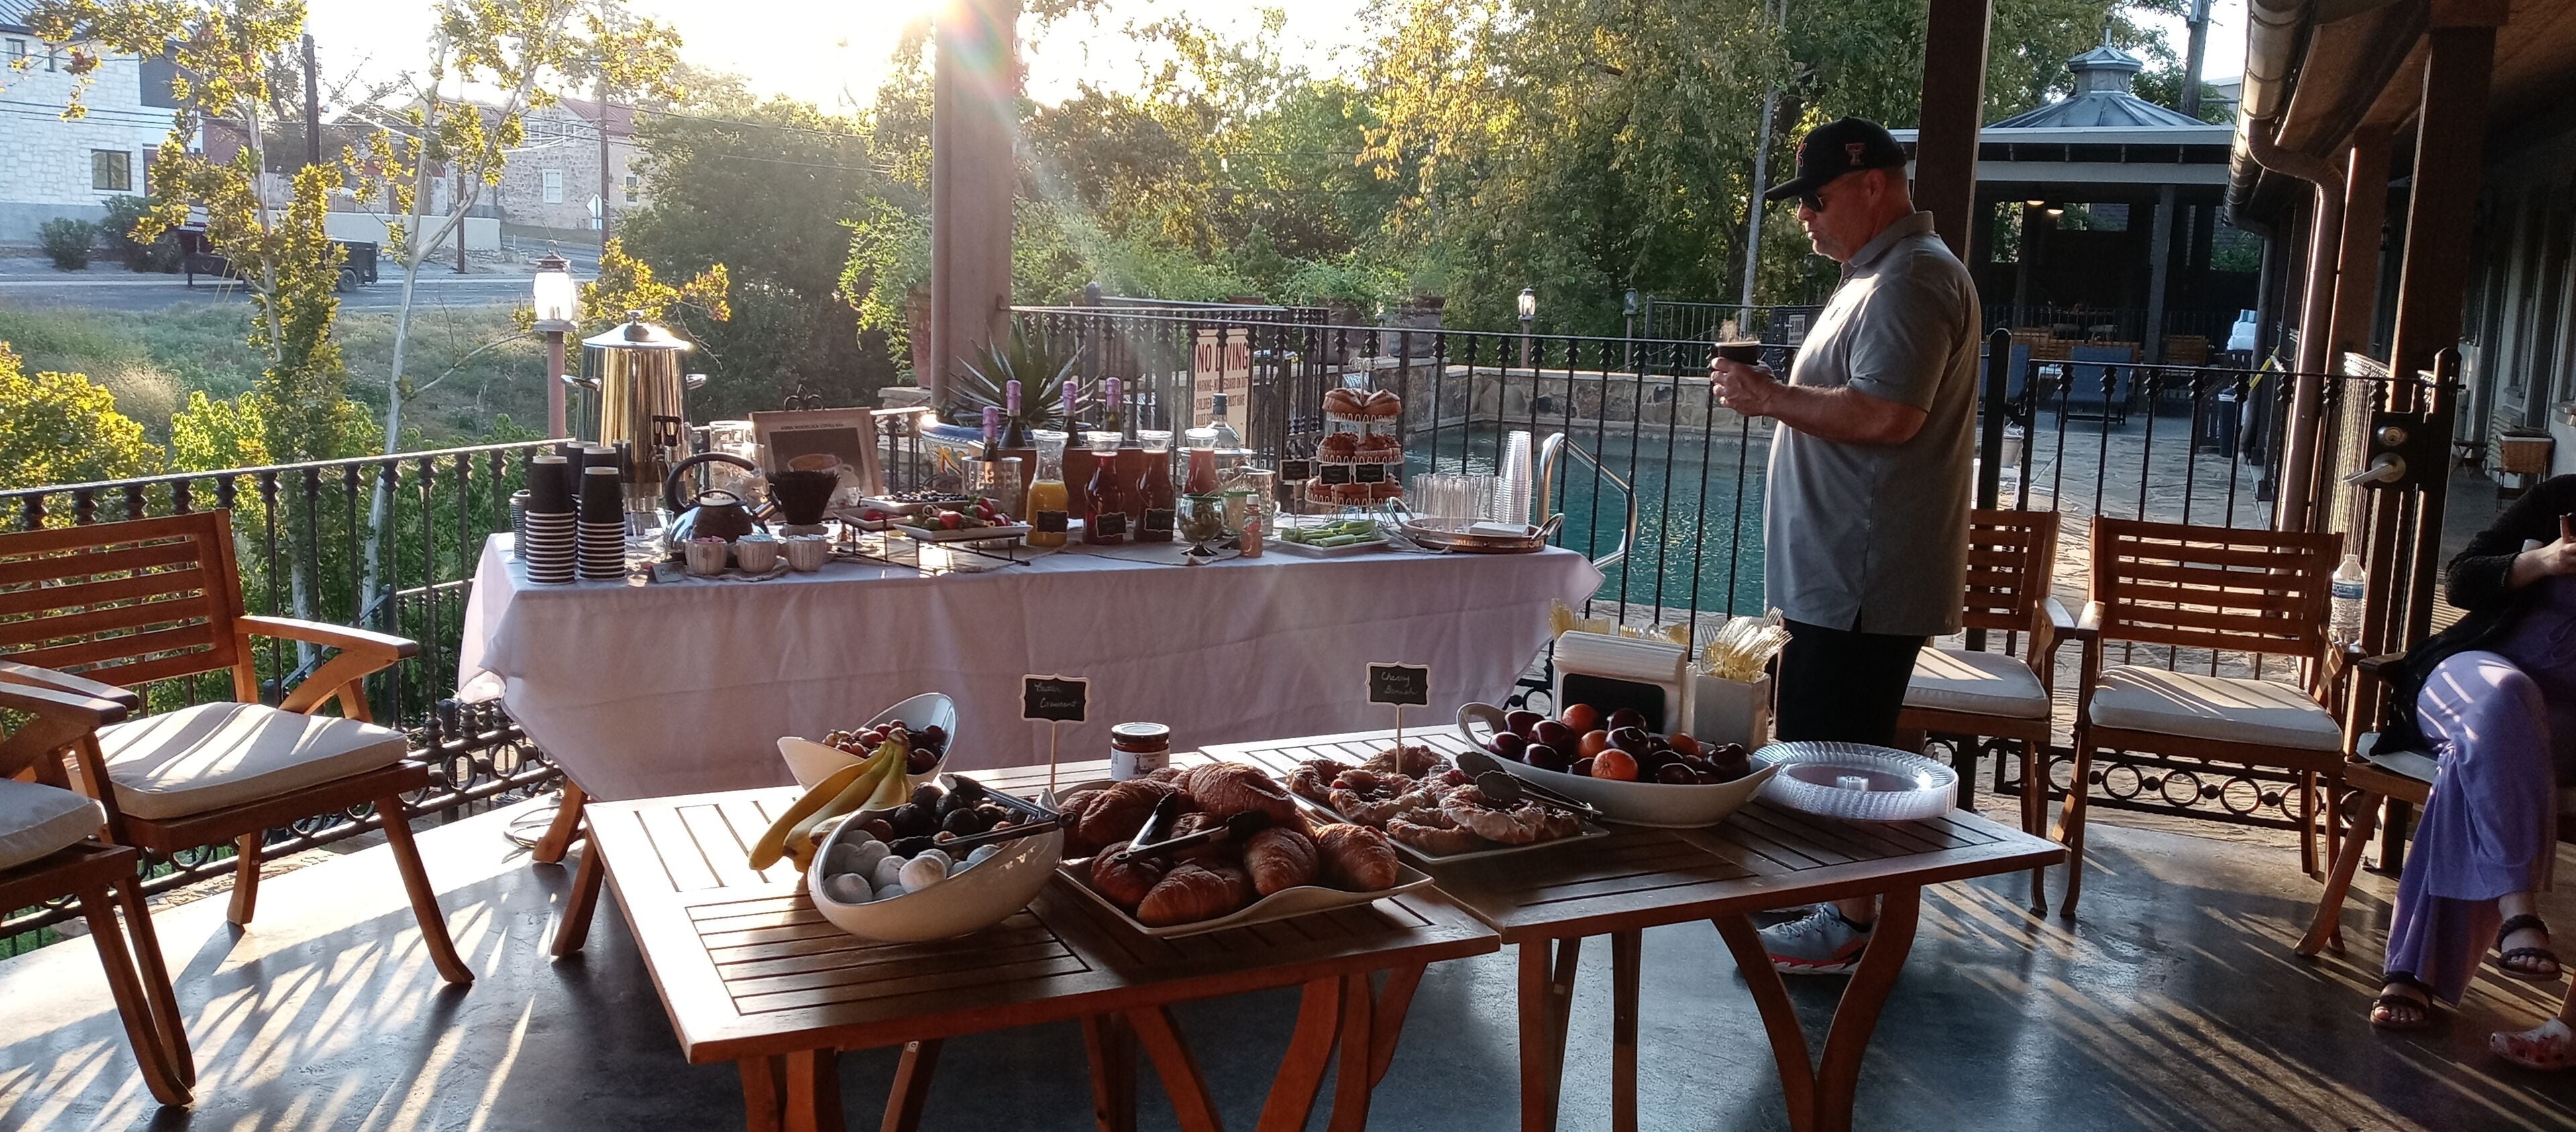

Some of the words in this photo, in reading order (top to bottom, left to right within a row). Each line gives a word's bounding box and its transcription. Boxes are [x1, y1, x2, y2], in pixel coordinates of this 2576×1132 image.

[1197, 344, 1212, 373] NO
[1216, 342, 1248, 371] DVING
[1236, 377, 1241, 389] ON
[1228, 395, 1236, 407] MUST
[1381, 671, 1411, 687] Cherry
